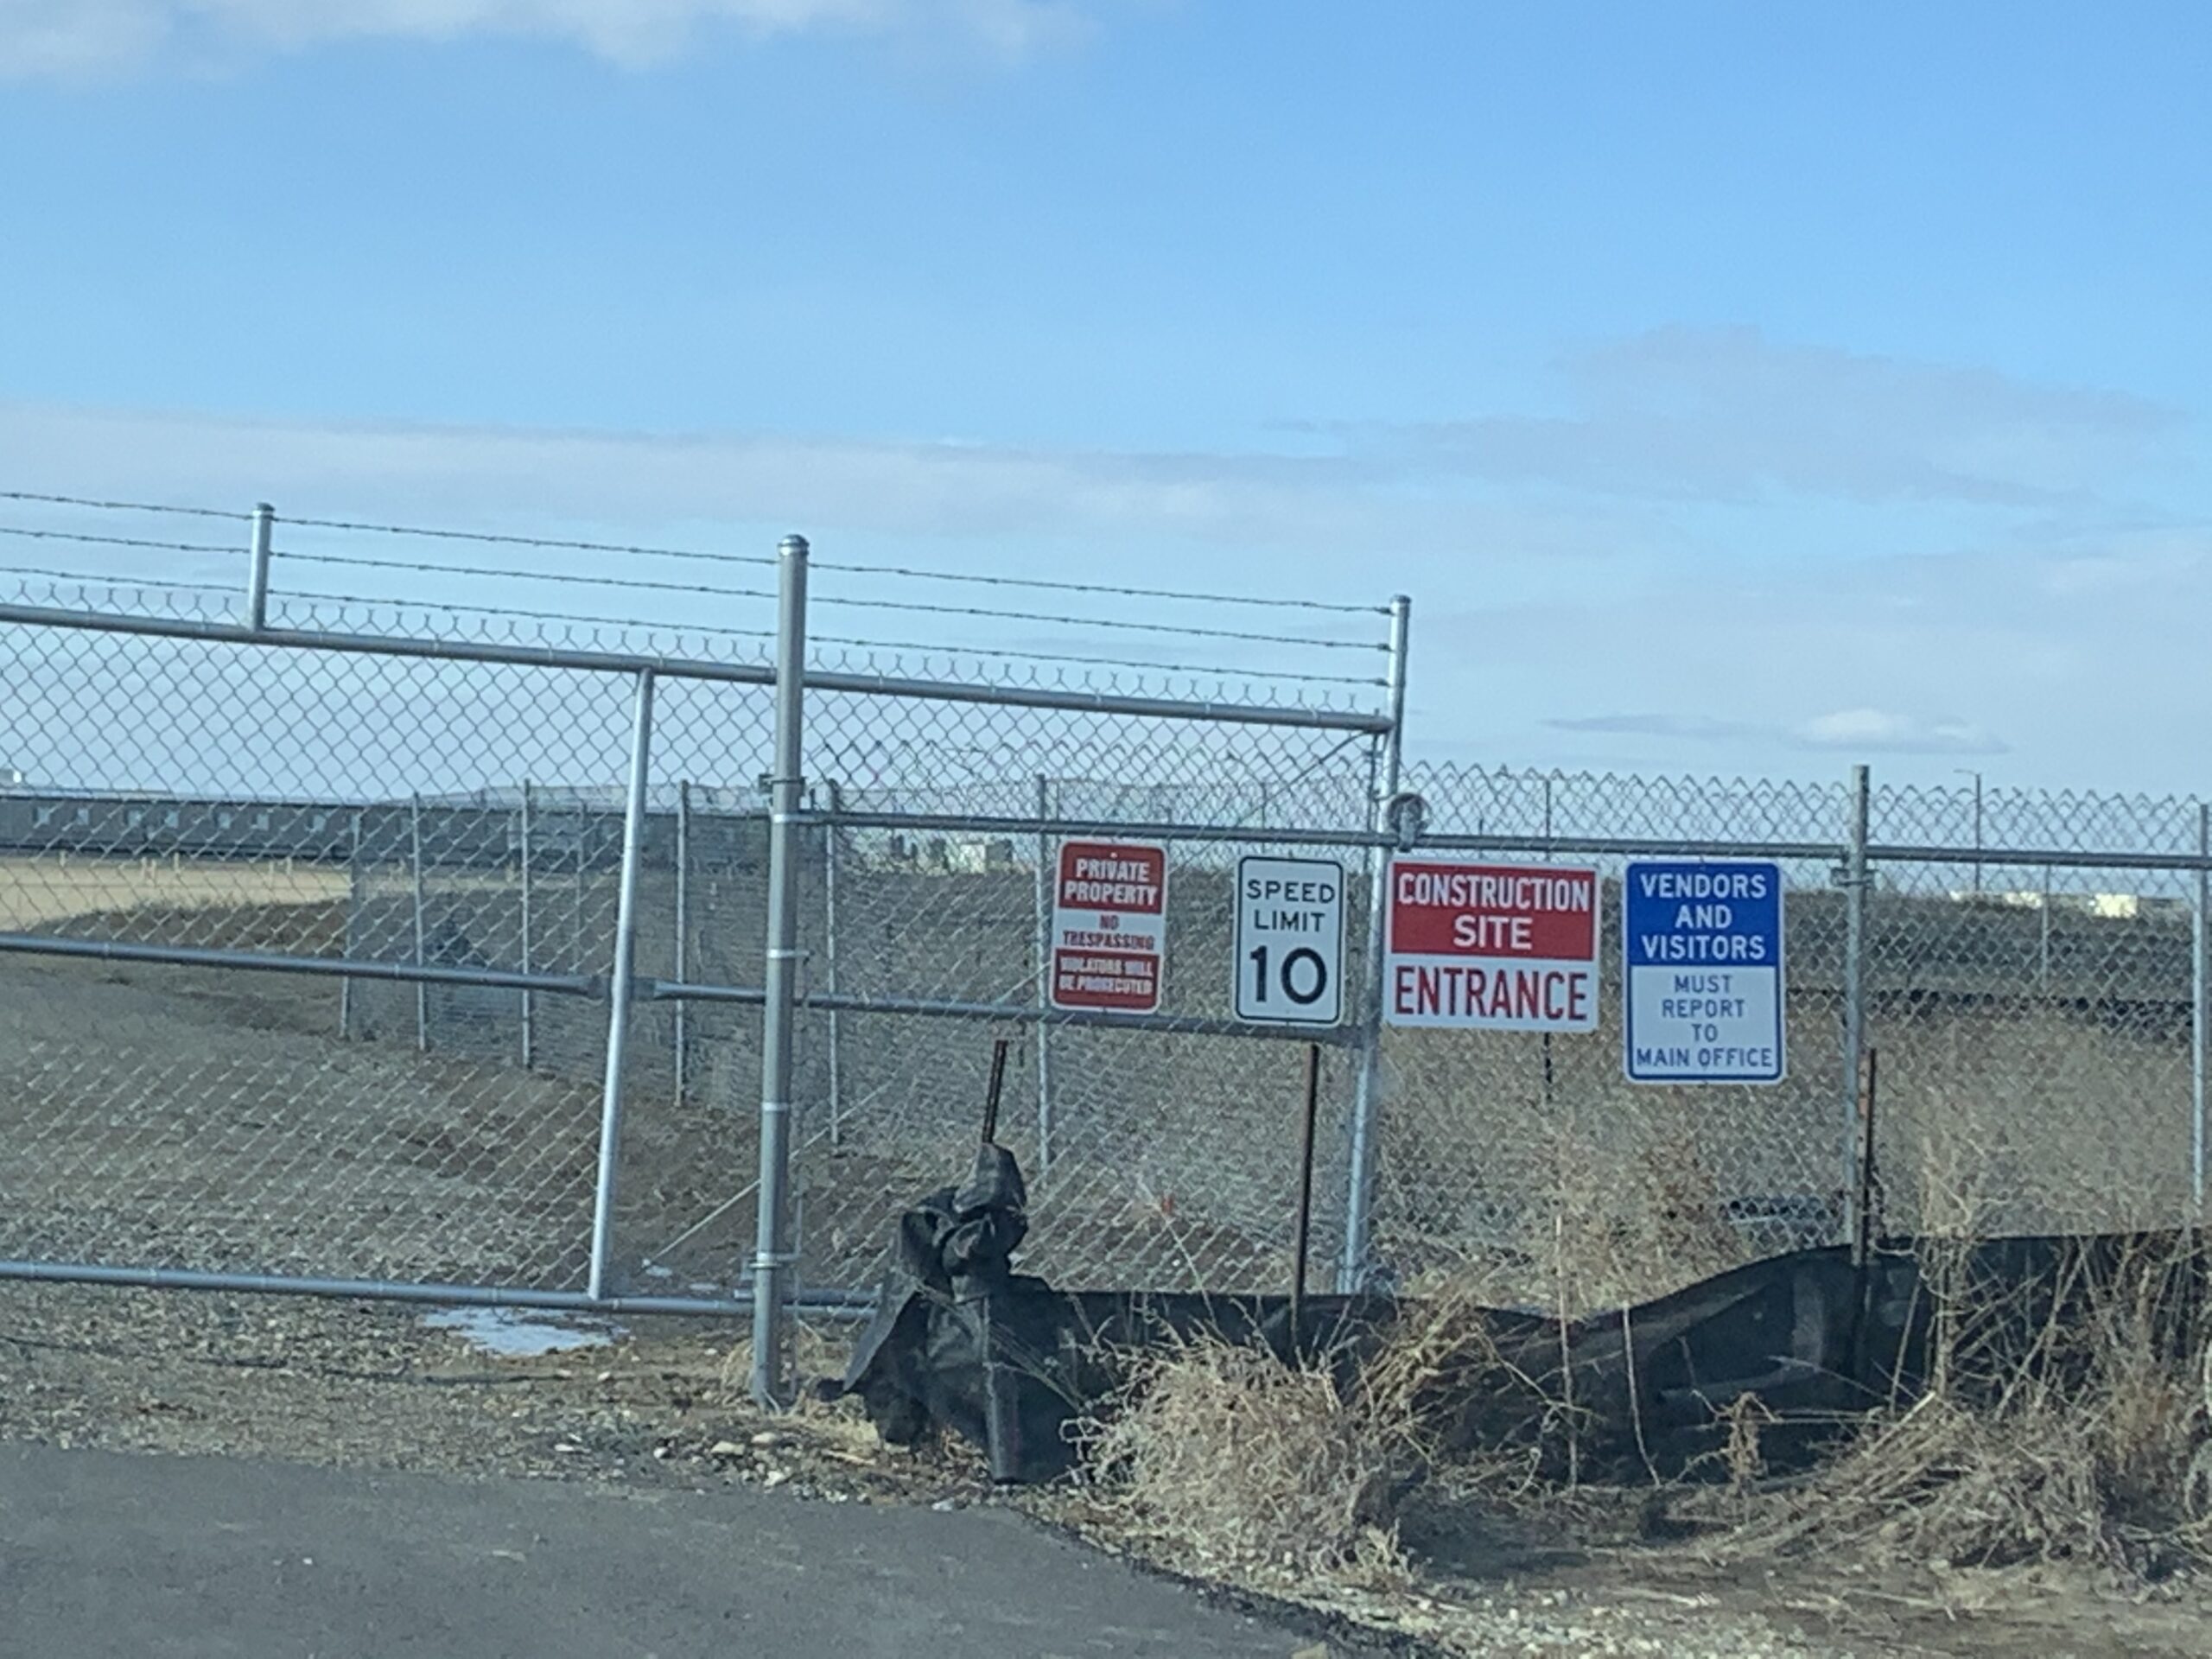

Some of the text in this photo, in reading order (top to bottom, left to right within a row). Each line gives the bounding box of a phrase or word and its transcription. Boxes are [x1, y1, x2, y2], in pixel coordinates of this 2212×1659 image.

[1076, 859, 1149, 881] PRIVATE
[1064, 881, 1157, 906] PROPERTY
[1246, 880, 1335, 904] SPEED
[1399, 873, 1589, 912] CONSTRUCTION
[1640, 873, 1767, 899] VENDORS
[1099, 915, 1120, 930] NO
[1254, 909, 1325, 932] LIMIT
[1675, 906, 1732, 929] AND
[1063, 931, 1154, 950] TRESPASSING
[1453, 915, 1533, 950] SITE
[1642, 935, 1765, 960] VISITORS
[1124, 961, 1154, 977] LL
[1249, 945, 1327, 1005] 10
[1077, 976, 1153, 995] PCUTED
[1395, 965, 1587, 1020] ENTRANCE
[1674, 975, 1732, 993] MUST
[1662, 999, 1745, 1019] REPORT
[1691, 1024, 1719, 1043] TO
[1637, 1048, 1772, 1068] MAIN OFFICE
